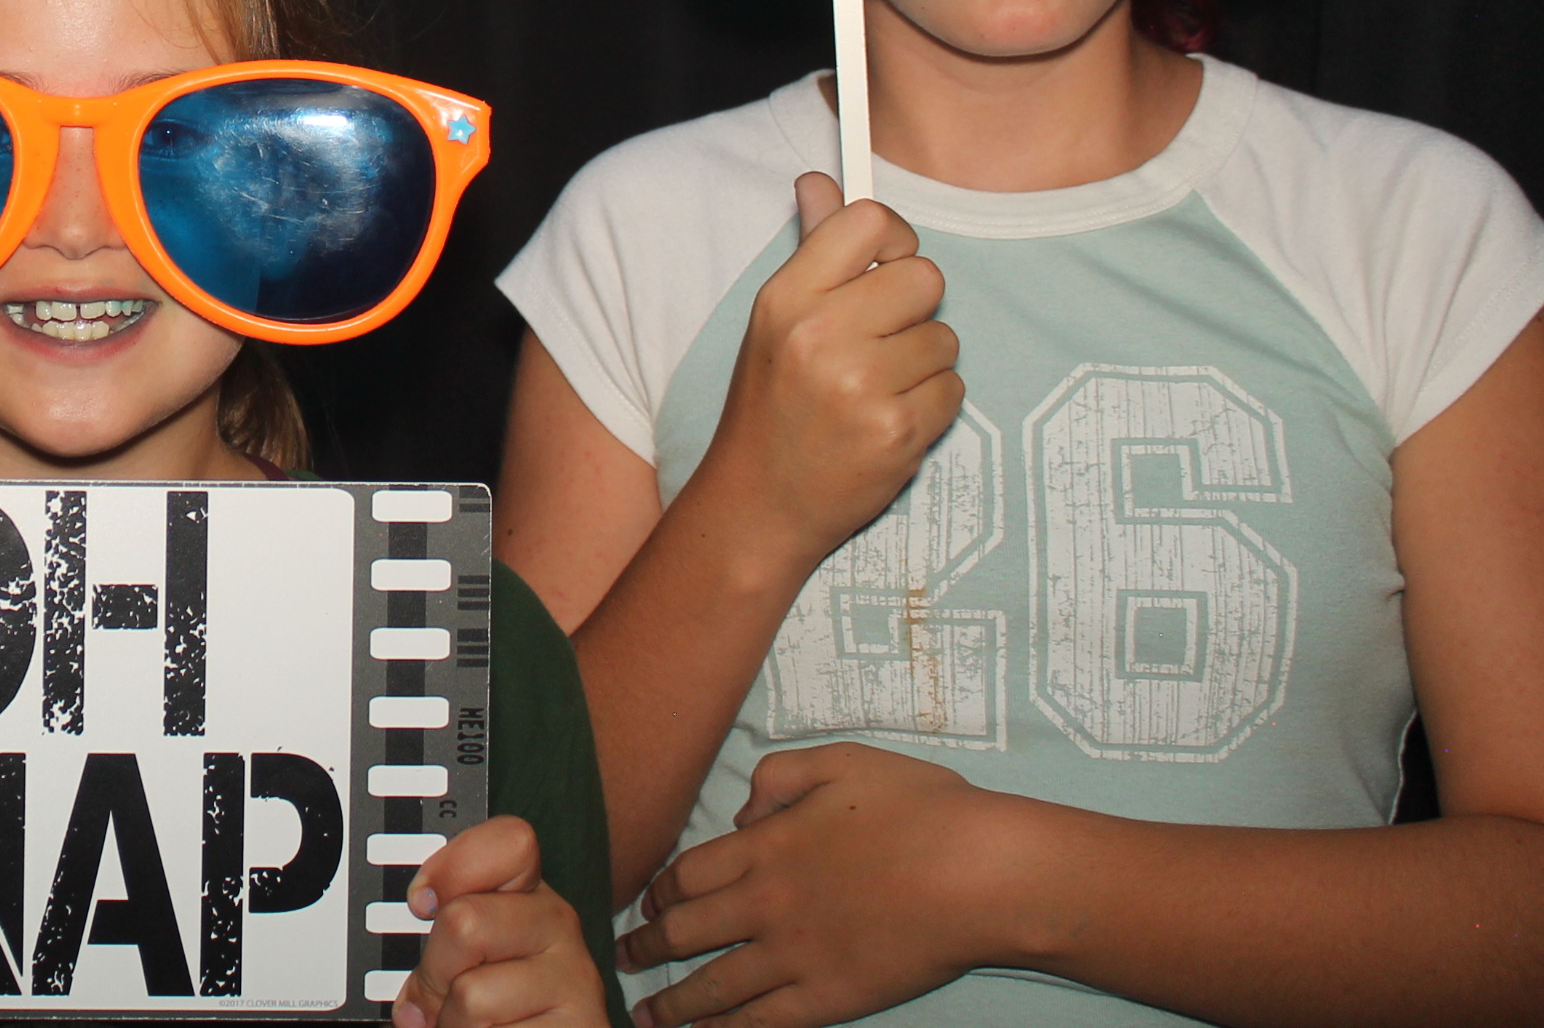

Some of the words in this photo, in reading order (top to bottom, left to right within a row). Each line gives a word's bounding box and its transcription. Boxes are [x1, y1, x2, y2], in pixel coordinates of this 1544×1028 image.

[767, 362, 1298, 764] 26
[246, 999, 277, 1008] CLOVER
[278, 999, 296, 1008] MILL
[298, 999, 339, 1008] GRAPHICS
